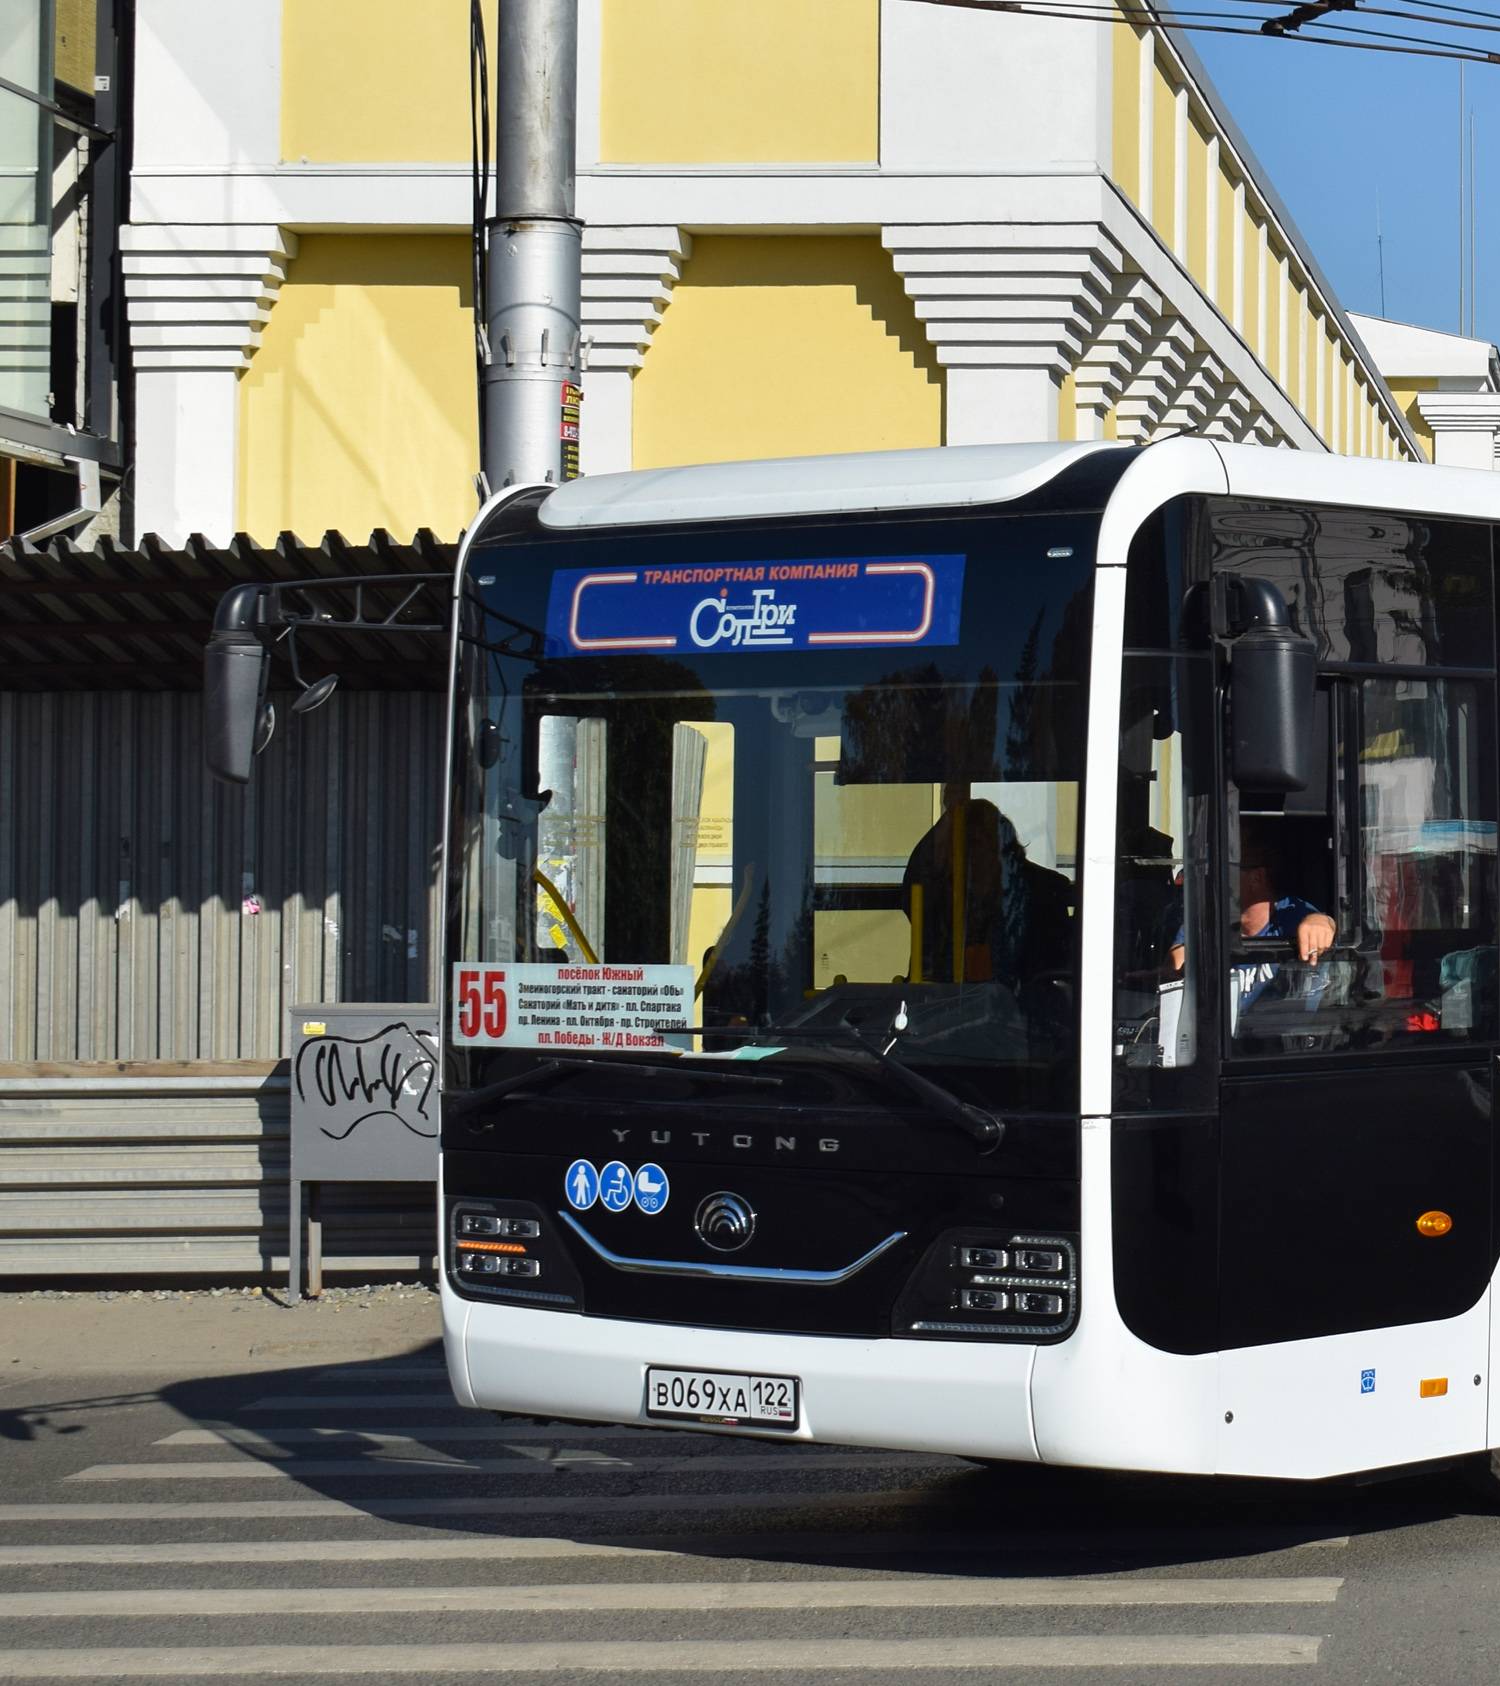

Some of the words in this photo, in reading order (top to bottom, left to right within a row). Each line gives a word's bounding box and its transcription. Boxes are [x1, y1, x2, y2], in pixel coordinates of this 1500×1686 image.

[644, 566, 765, 584] ТРАНСПОРТНАЯ
[769, 564, 859, 581] КОМПАНИЯ
[558, 966, 600, 980] посёлок
[602, 967, 644, 980] Южный
[518, 982, 582, 995] Змеиногорский
[583, 985, 606, 995] тракт
[612, 984, 658, 996] санаторий
[458, 970, 507, 1038] 55
[518, 998, 561, 1011] Санаторий
[588, 1002, 593, 1010] и
[640, 1001, 681, 1013] Спартака
[531, 1014, 560, 1026] Ленина
[580, 1015, 614, 1028] Октября
[635, 1017, 687, 1029] Строителей
[538, 1032, 552, 1043] пл.
[554, 1031, 595, 1046] Победы
[602, 1032, 624, 1048] Ж/Д
[626, 1033, 665, 1047] Вокзал
[611, 1128, 840, 1152] YUTONG
[657, 1376, 748, 1413] В069ХА
[753, 1381, 788, 1407] 122
[760, 1406, 778, 1416] RUS
